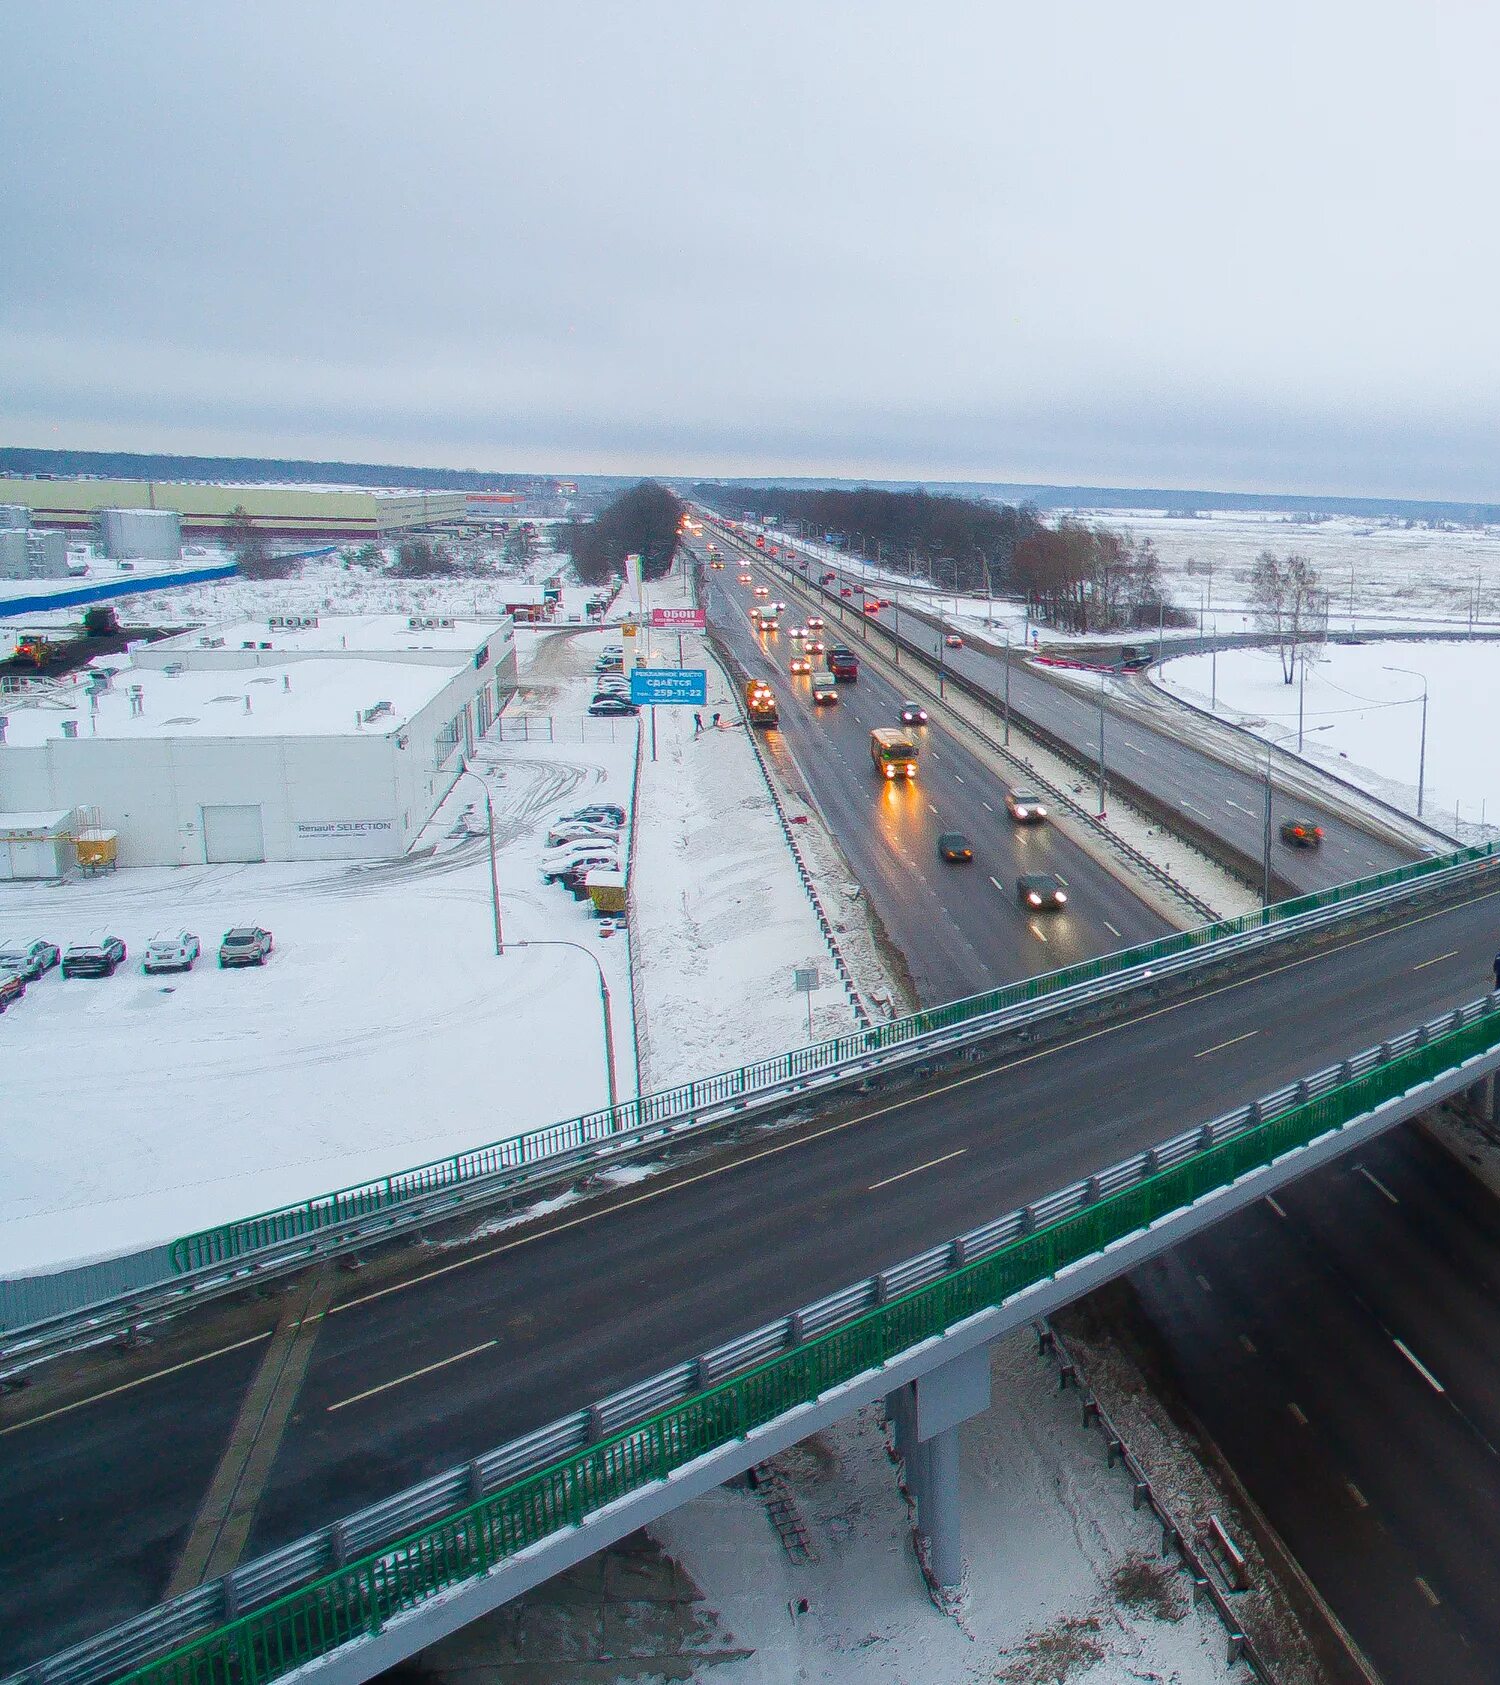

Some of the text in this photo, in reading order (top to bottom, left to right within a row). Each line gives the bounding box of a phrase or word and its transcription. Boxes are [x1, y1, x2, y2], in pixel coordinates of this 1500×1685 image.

[663, 610, 695, 618] ОБОИ
[653, 689, 702, 697] 259-11-22
[298, 822, 391, 832] Renault SELECTION
